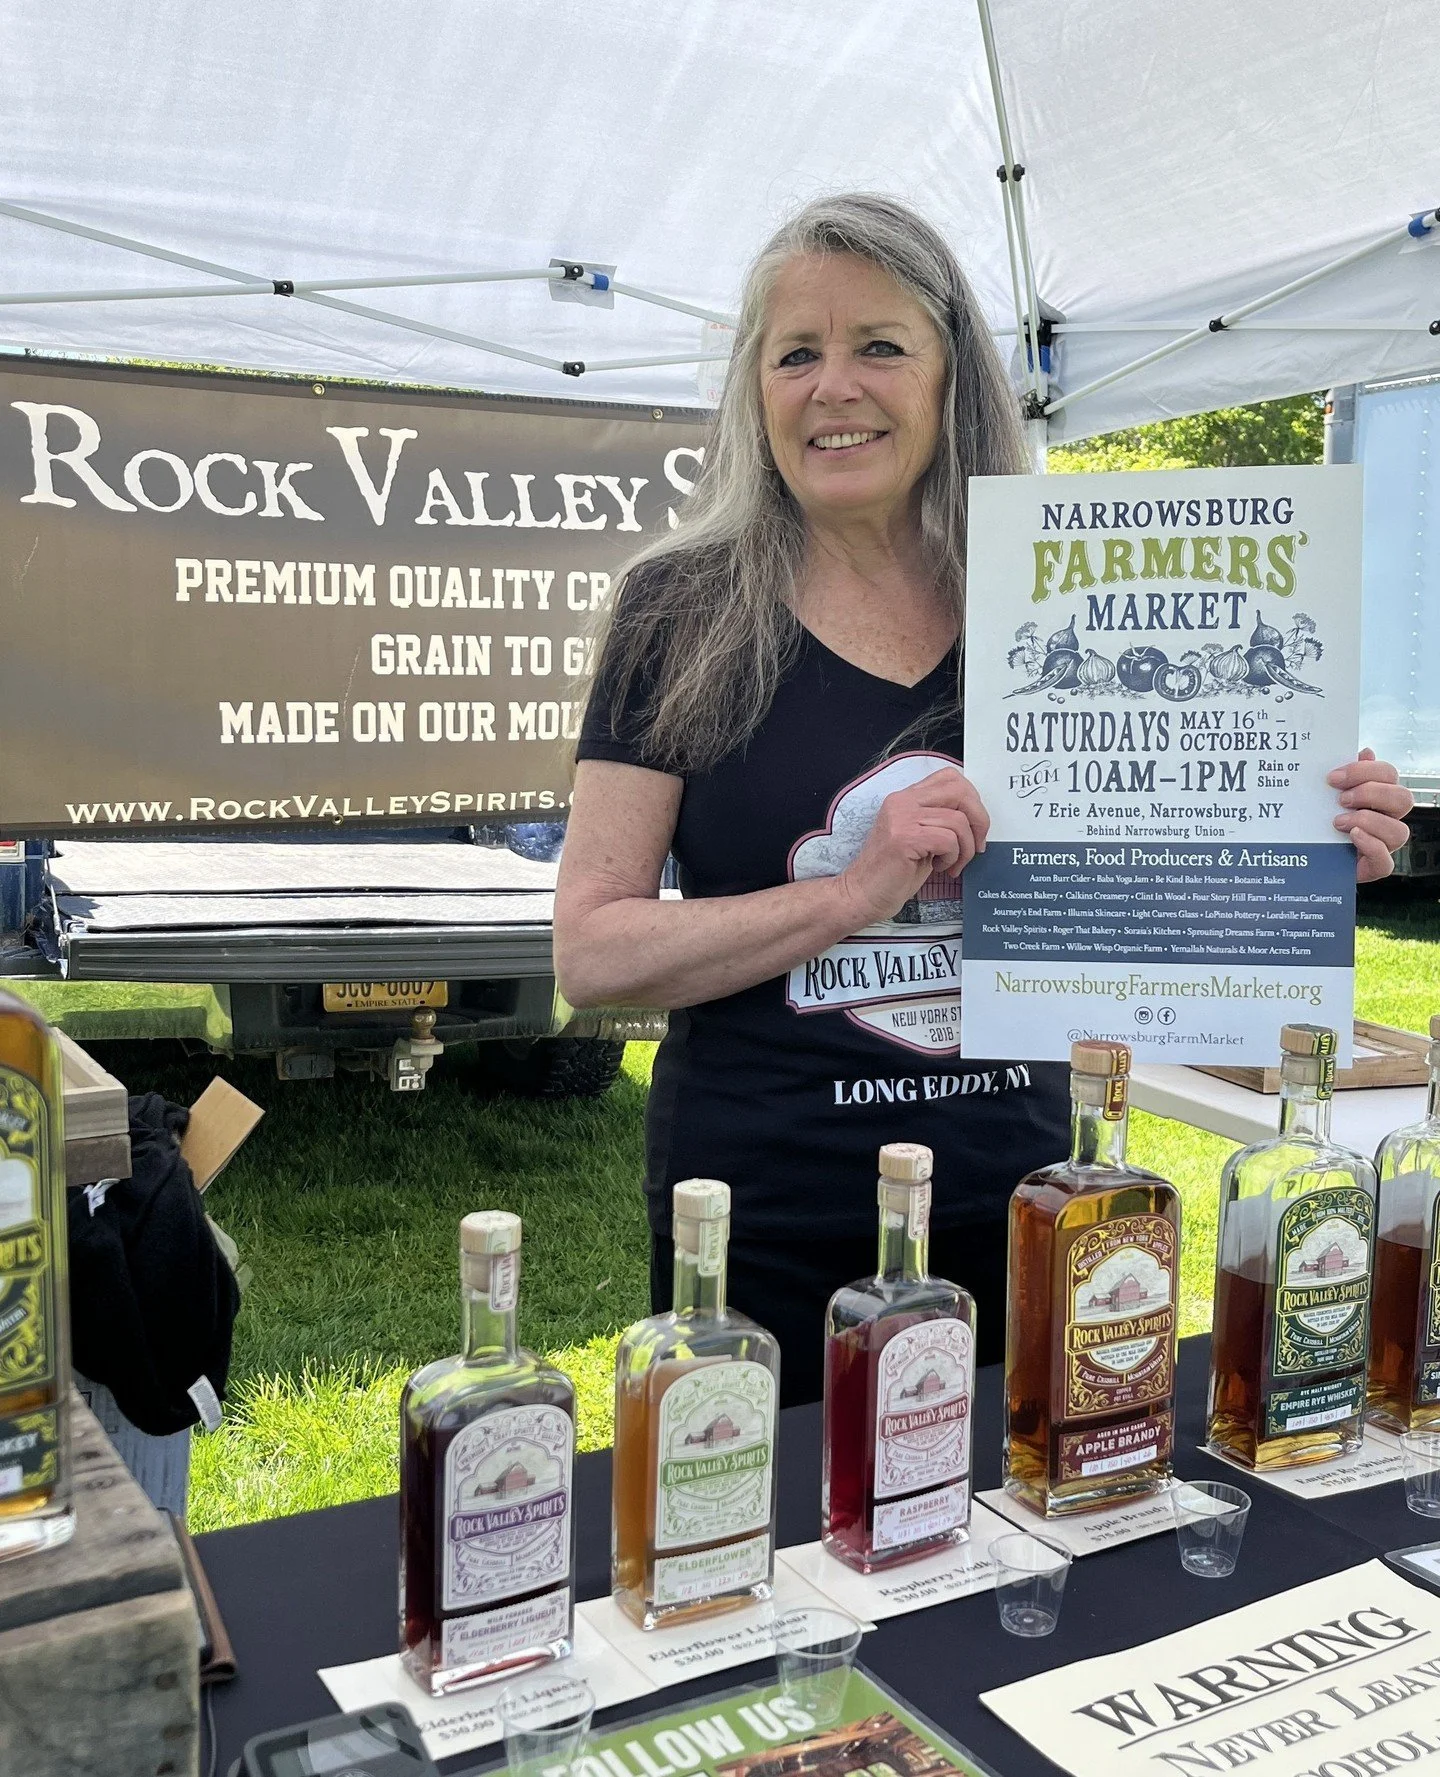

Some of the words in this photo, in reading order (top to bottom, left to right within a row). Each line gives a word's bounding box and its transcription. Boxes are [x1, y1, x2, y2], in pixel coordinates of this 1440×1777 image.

[1042, 497, 1294, 530] NARROWSBURG
[1032, 531, 1309, 603] FARMERS'
[175, 558, 376, 607] PREMIUM
[389, 567, 555, 611] QUALITY
[1086, 592, 1247, 631] MARKET
[371, 634, 492, 676] GRAIN
[504, 636, 552, 676] TO
[220, 702, 340, 744] MADE
[352, 703, 406, 743] ON
[419, 703, 496, 742] OUR
[1180, 710, 1226, 729] MAY
[1231, 709, 1268, 729] 16th
[1006, 710, 1170, 752] SATURDAYS
[1180, 733, 1271, 751] OCTOBER
[1277, 730, 1310, 750] 31st
[1258, 760, 1284, 772] Rain
[1287, 762, 1299, 772] or
[1009, 768, 1060, 790] FROM
[1257, 775, 1289, 788] Shine
[1033, 803, 1042, 818] 7
[1049, 803, 1080, 818] Erie
[1086, 803, 1145, 820] Avenue,
[1150, 803, 1252, 823] Narrowsburg,
[1258, 803, 1283, 818] NY
[1087, 824, 1121, 836] Behind
[1125, 825, 1189, 839] Narrowsburg
[1195, 825, 1225, 836] Union
[1012, 847, 1080, 867] Farmers,
[1085, 848, 1125, 865] Food
[1131, 848, 1212, 866] Producers
[1218, 849, 1233, 866] &
[1238, 849, 1308, 867] Artisans
[1097, 875, 1114, 883] Baba
[1116, 876, 1132, 885] Yoga
[1234, 876, 1262, 884] Botanic
[1008, 891, 1032, 899] Scones
[1034, 891, 1058, 901] Bakery
[1065, 892, 1093, 900] Calkins
[1095, 893, 1129, 902] Creamery
[1211, 894, 1230, 903] Story
[1095, 909, 1126, 917] Skincare
[1133, 910, 1150, 919] Light
[1234, 912, 1260, 921] Pottery
[1001, 925, 1023, 934] Valley
[1024, 925, 1047, 935] Spirits
[1053, 926, 1074, 935] Roger
[1075, 926, 1090, 934] That
[1092, 927, 1116, 936] Bakery
[1153, 927, 1181, 935] Kitchen
[1187, 928, 1223, 938] Sprouting
[1020, 942, 1040, 950] Creek
[1066, 943, 1092, 951] Willow
[1094, 944, 1113, 953] Wisp
[1114, 944, 1142, 954] Organic
[1239, 946, 1246, 954] &
[1292, 947, 1310, 955] Farm
[995, 971, 1322, 1006] NarrowsburgFarmersMarket.org
[355, 1000, 389, 1008] EMPIRE
[892, 1012, 918, 1027] NEW
[921, 1009, 949, 1025] YORK
[1067, 1028, 1244, 1047] @NarrowsburgFarmMarket
[834, 1079, 917, 1105] LONG
[922, 1070, 1001, 1100] EDDY,
[1005, 1063, 1032, 1090] NY
[1281, 1399, 1310, 1411] EMPIRE
[1311, 1396, 1326, 1405] RYE
[1327, 1387, 1357, 1402] WHISKEY
[1076, 1439, 1115, 1456] APPLE
[1118, 1425, 1161, 1447] BRANDY
[900, 1495, 949, 1516] RASPBERRY
[678, 1549, 752, 1571] ELDERFLOWER
[878, 1571, 953, 1597] Raspberry
[649, 1631, 742, 1662] Elderflower
[1071, 1606, 1418, 1738] WARNING
[737, 1695, 817, 1741] US
[1150, 1709, 1342, 1777] NEVER
